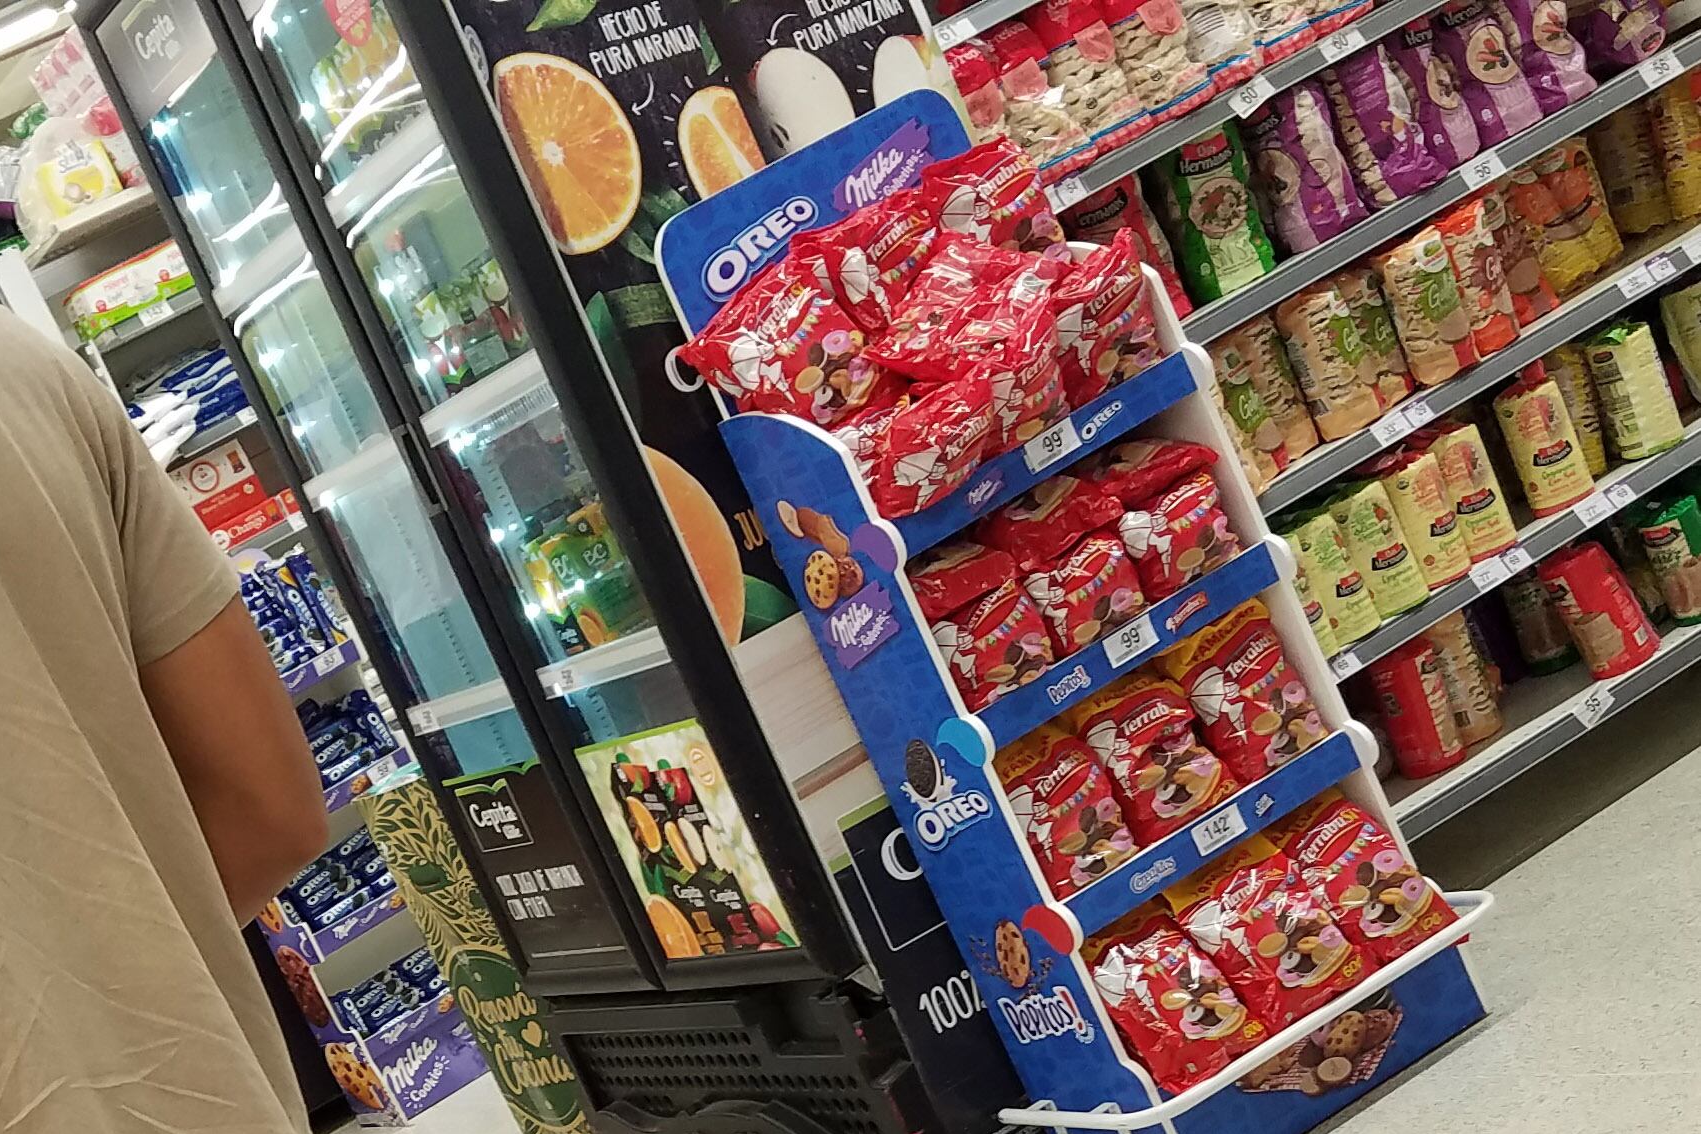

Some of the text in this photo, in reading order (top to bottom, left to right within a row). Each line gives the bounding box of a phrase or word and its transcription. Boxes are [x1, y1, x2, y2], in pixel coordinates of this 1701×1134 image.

[134, 11, 177, 62] Cepita
[598, 3, 668, 42] HECHO DE
[792, 0, 905, 53] PURA MANZANA
[588, 24, 702, 79] PURA NARANJA
[1239, 85, 1259, 105] 60
[845, 149, 903, 207] Milka
[1180, 150, 1235, 175] Hermanos
[706, 199, 813, 294] OREO
[1081, 399, 1124, 444] OREO
[733, 509, 764, 551] JU
[830, 602, 873, 649] Milka
[1120, 628, 1142, 650] 99
[1120, 702, 1171, 737] Terrab
[469, 801, 518, 833] Cepita
[916, 790, 989, 845] OREO
[1204, 816, 1230, 842] 142
[299, 870, 331, 898] OREO
[918, 968, 988, 1035] 100%
[999, 985, 1088, 1044] Pepitos!
[382, 1036, 438, 1094] Milka
[409, 1061, 445, 1103] Cookies
